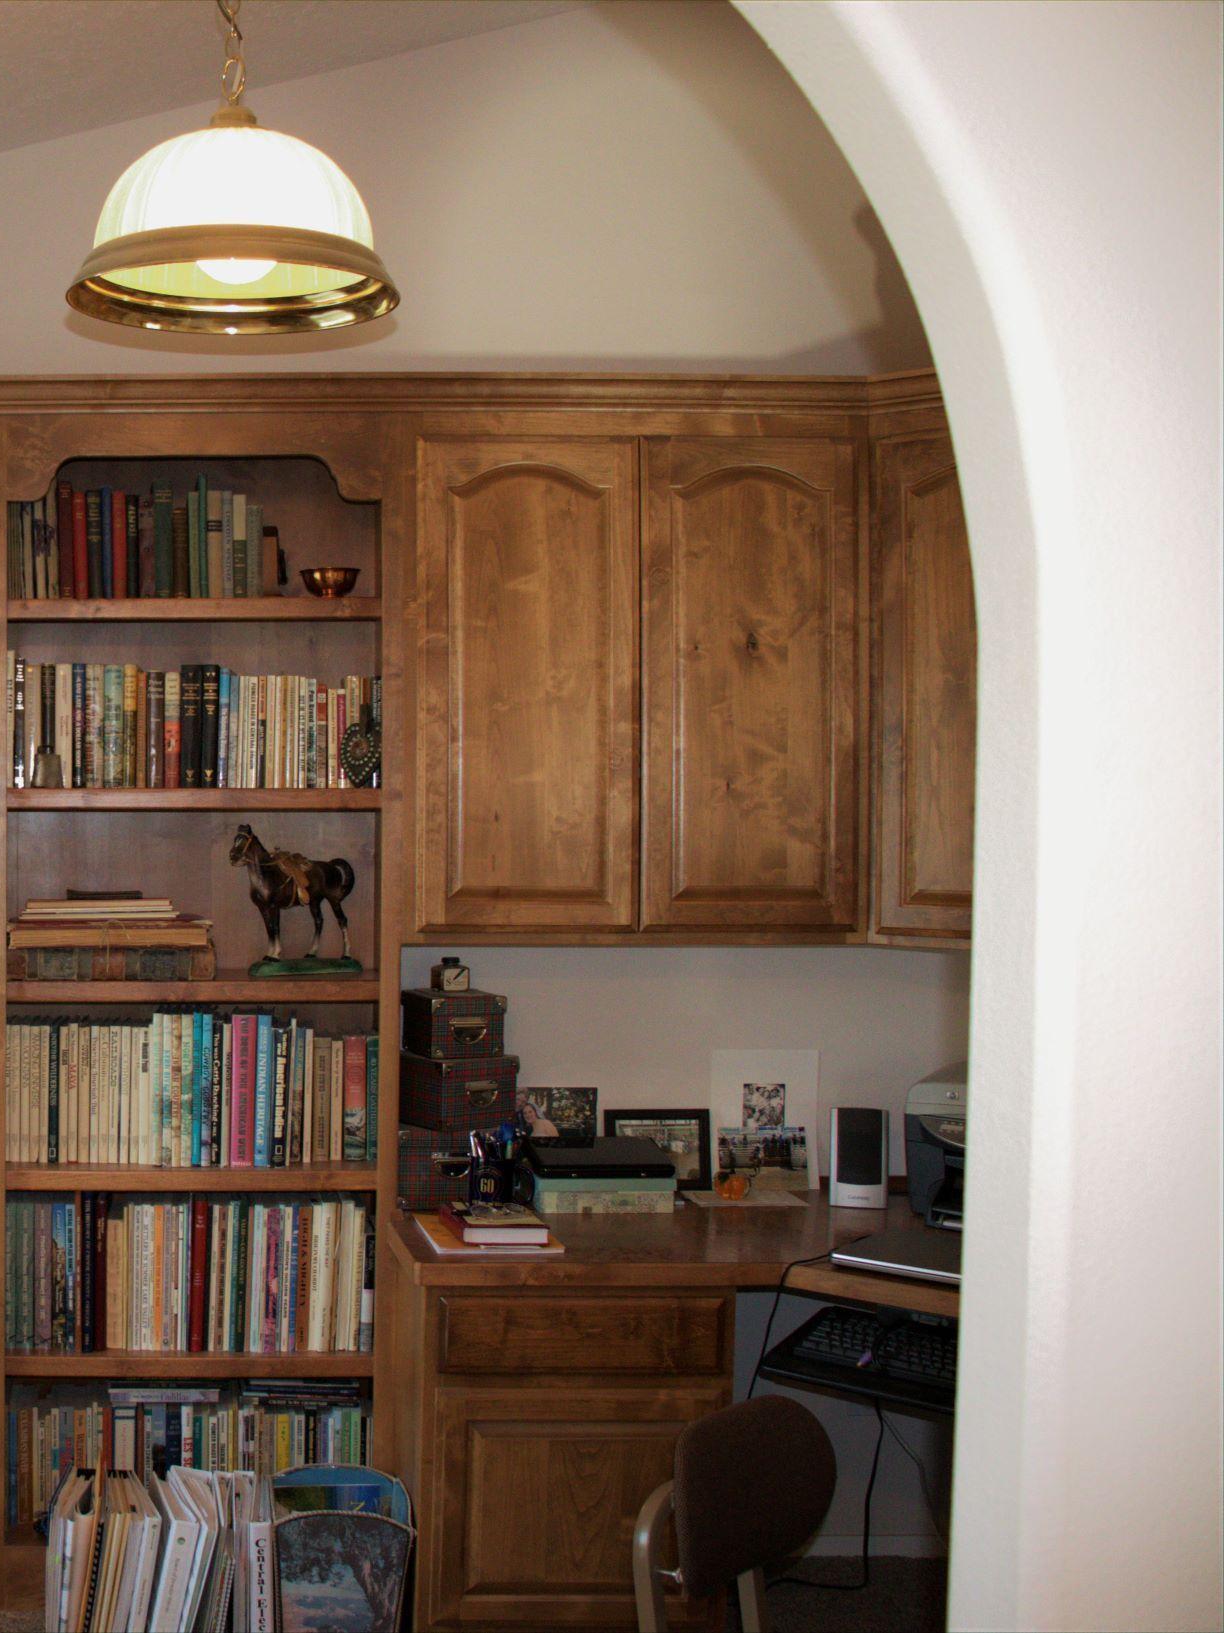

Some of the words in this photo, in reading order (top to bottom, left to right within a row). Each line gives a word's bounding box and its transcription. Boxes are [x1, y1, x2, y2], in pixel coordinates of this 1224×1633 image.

[68, 1063, 77, 1090] MAYA
[258, 1052, 267, 1091] INDIAN
[275, 1056, 286, 1106] American
[211, 1085, 220, 1122] Ranching
[256, 1094, 265, 1147] HERITAGE
[274, 1106, 286, 1138] Indian
[479, 1177, 495, 1194] 60
[255, 1538, 266, 1595] Central
